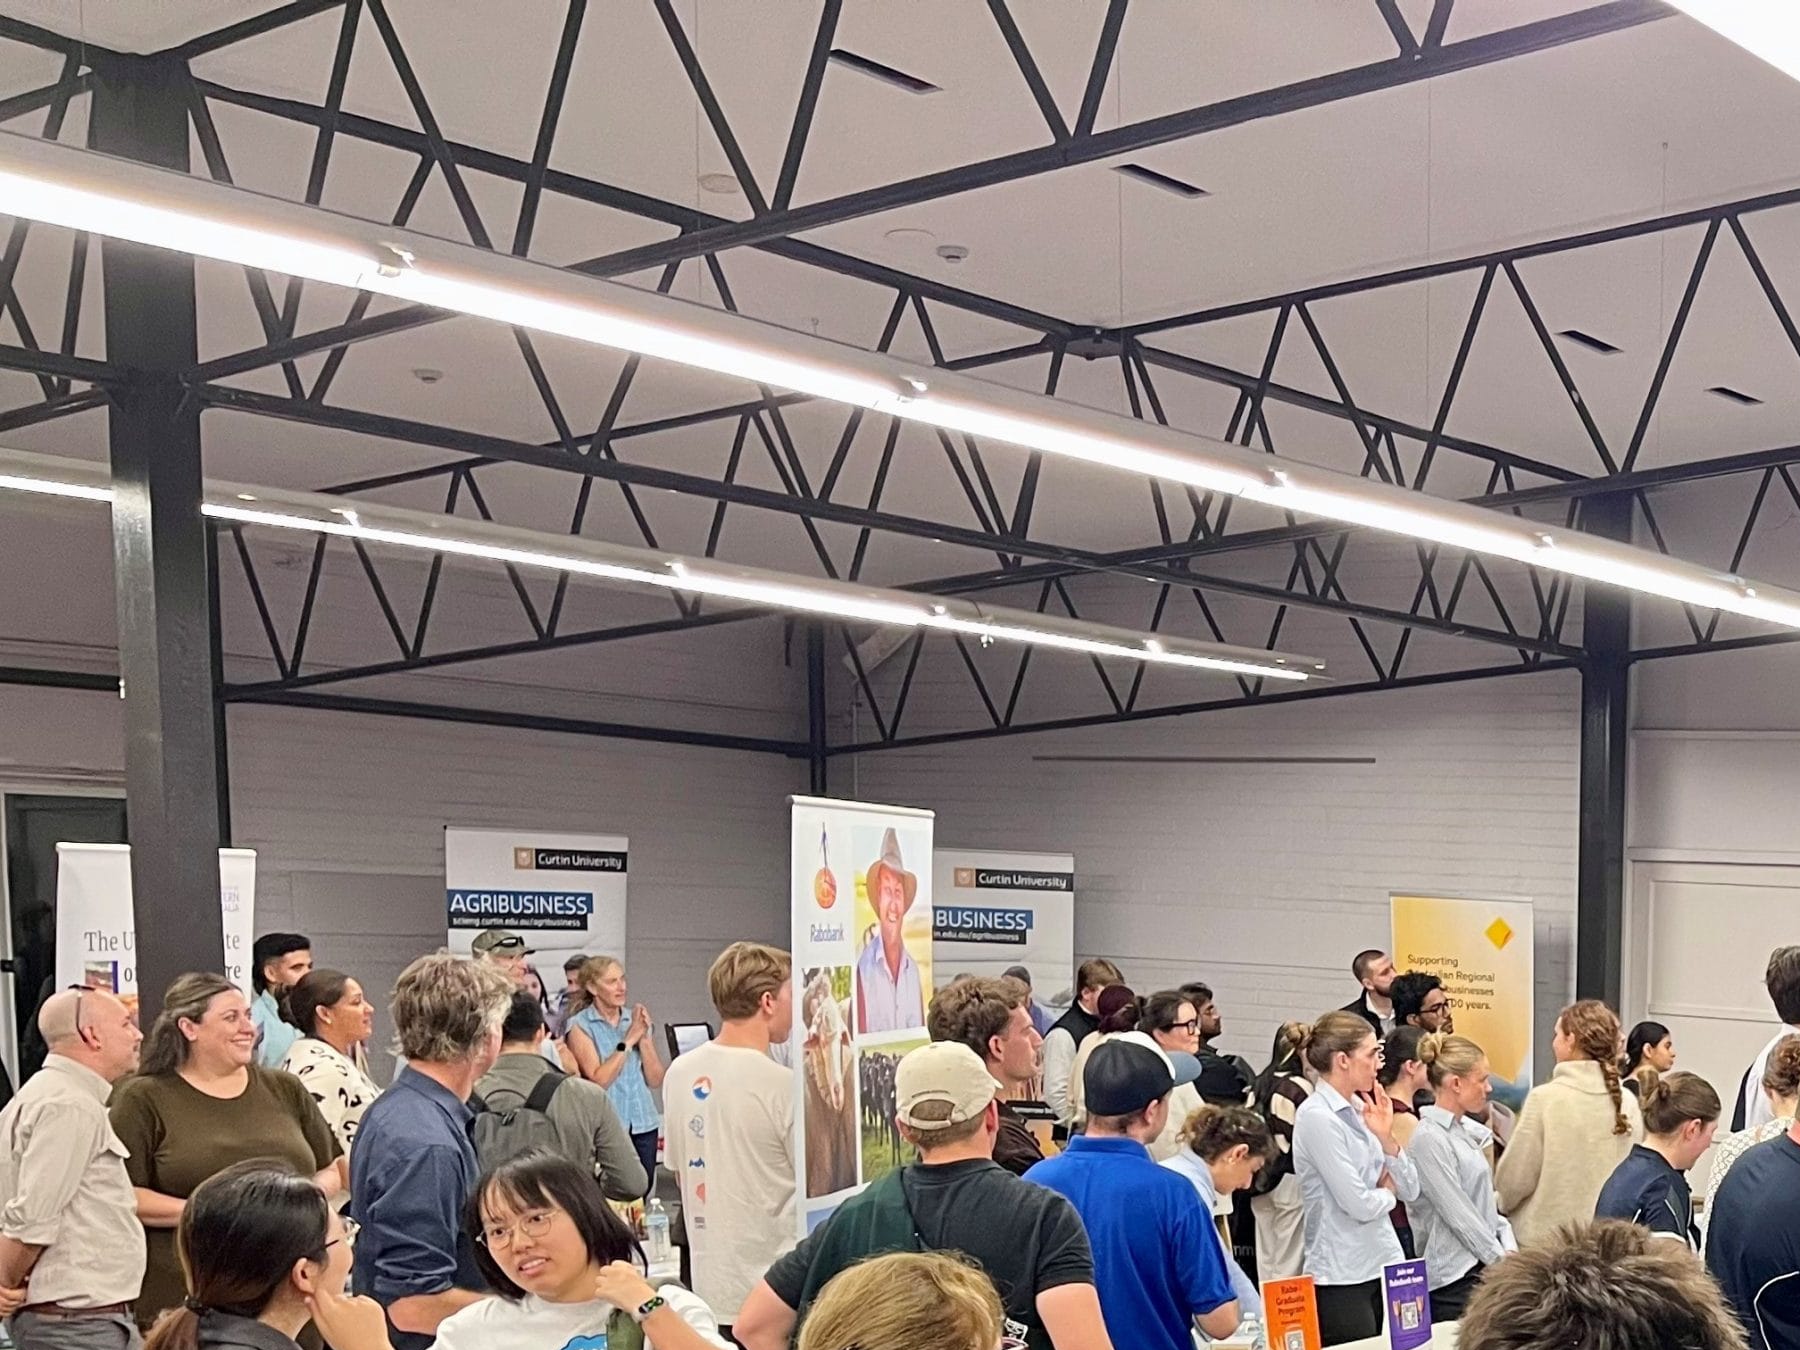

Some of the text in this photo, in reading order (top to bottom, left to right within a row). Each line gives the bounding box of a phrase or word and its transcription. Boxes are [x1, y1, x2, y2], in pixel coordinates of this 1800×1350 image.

[538, 853, 622, 870] Curtin University
[978, 873, 1067, 888] Curtin University
[450, 893, 588, 915] AGRIBUSINESS
[936, 911, 1027, 930] BUSINESS
[84, 930, 118, 952] The
[1407, 954, 1459, 967] Supporting
[1456, 971, 1495, 982] Regional
[1465, 1001, 1492, 1010] years.
